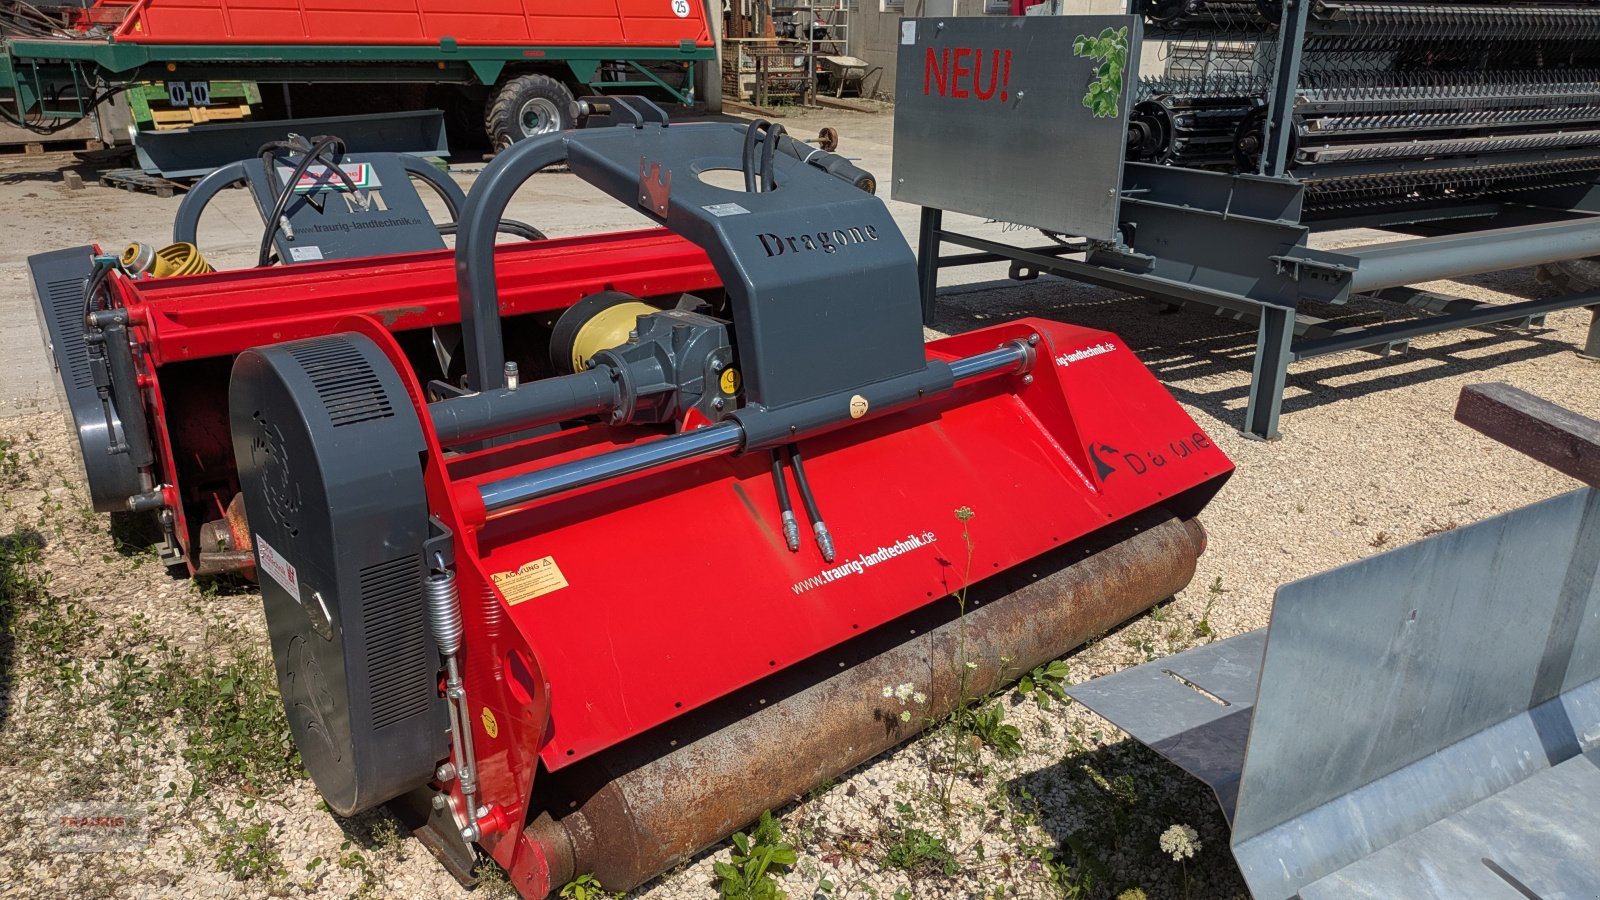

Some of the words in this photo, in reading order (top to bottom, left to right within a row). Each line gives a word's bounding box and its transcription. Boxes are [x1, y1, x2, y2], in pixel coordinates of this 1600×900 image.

[675, 1, 687, 13] 25
[924, 47, 1012, 103] NEU!
[755, 224, 880, 257] Dragone
[791, 531, 937, 595] www.traurig-landtechnik.de
